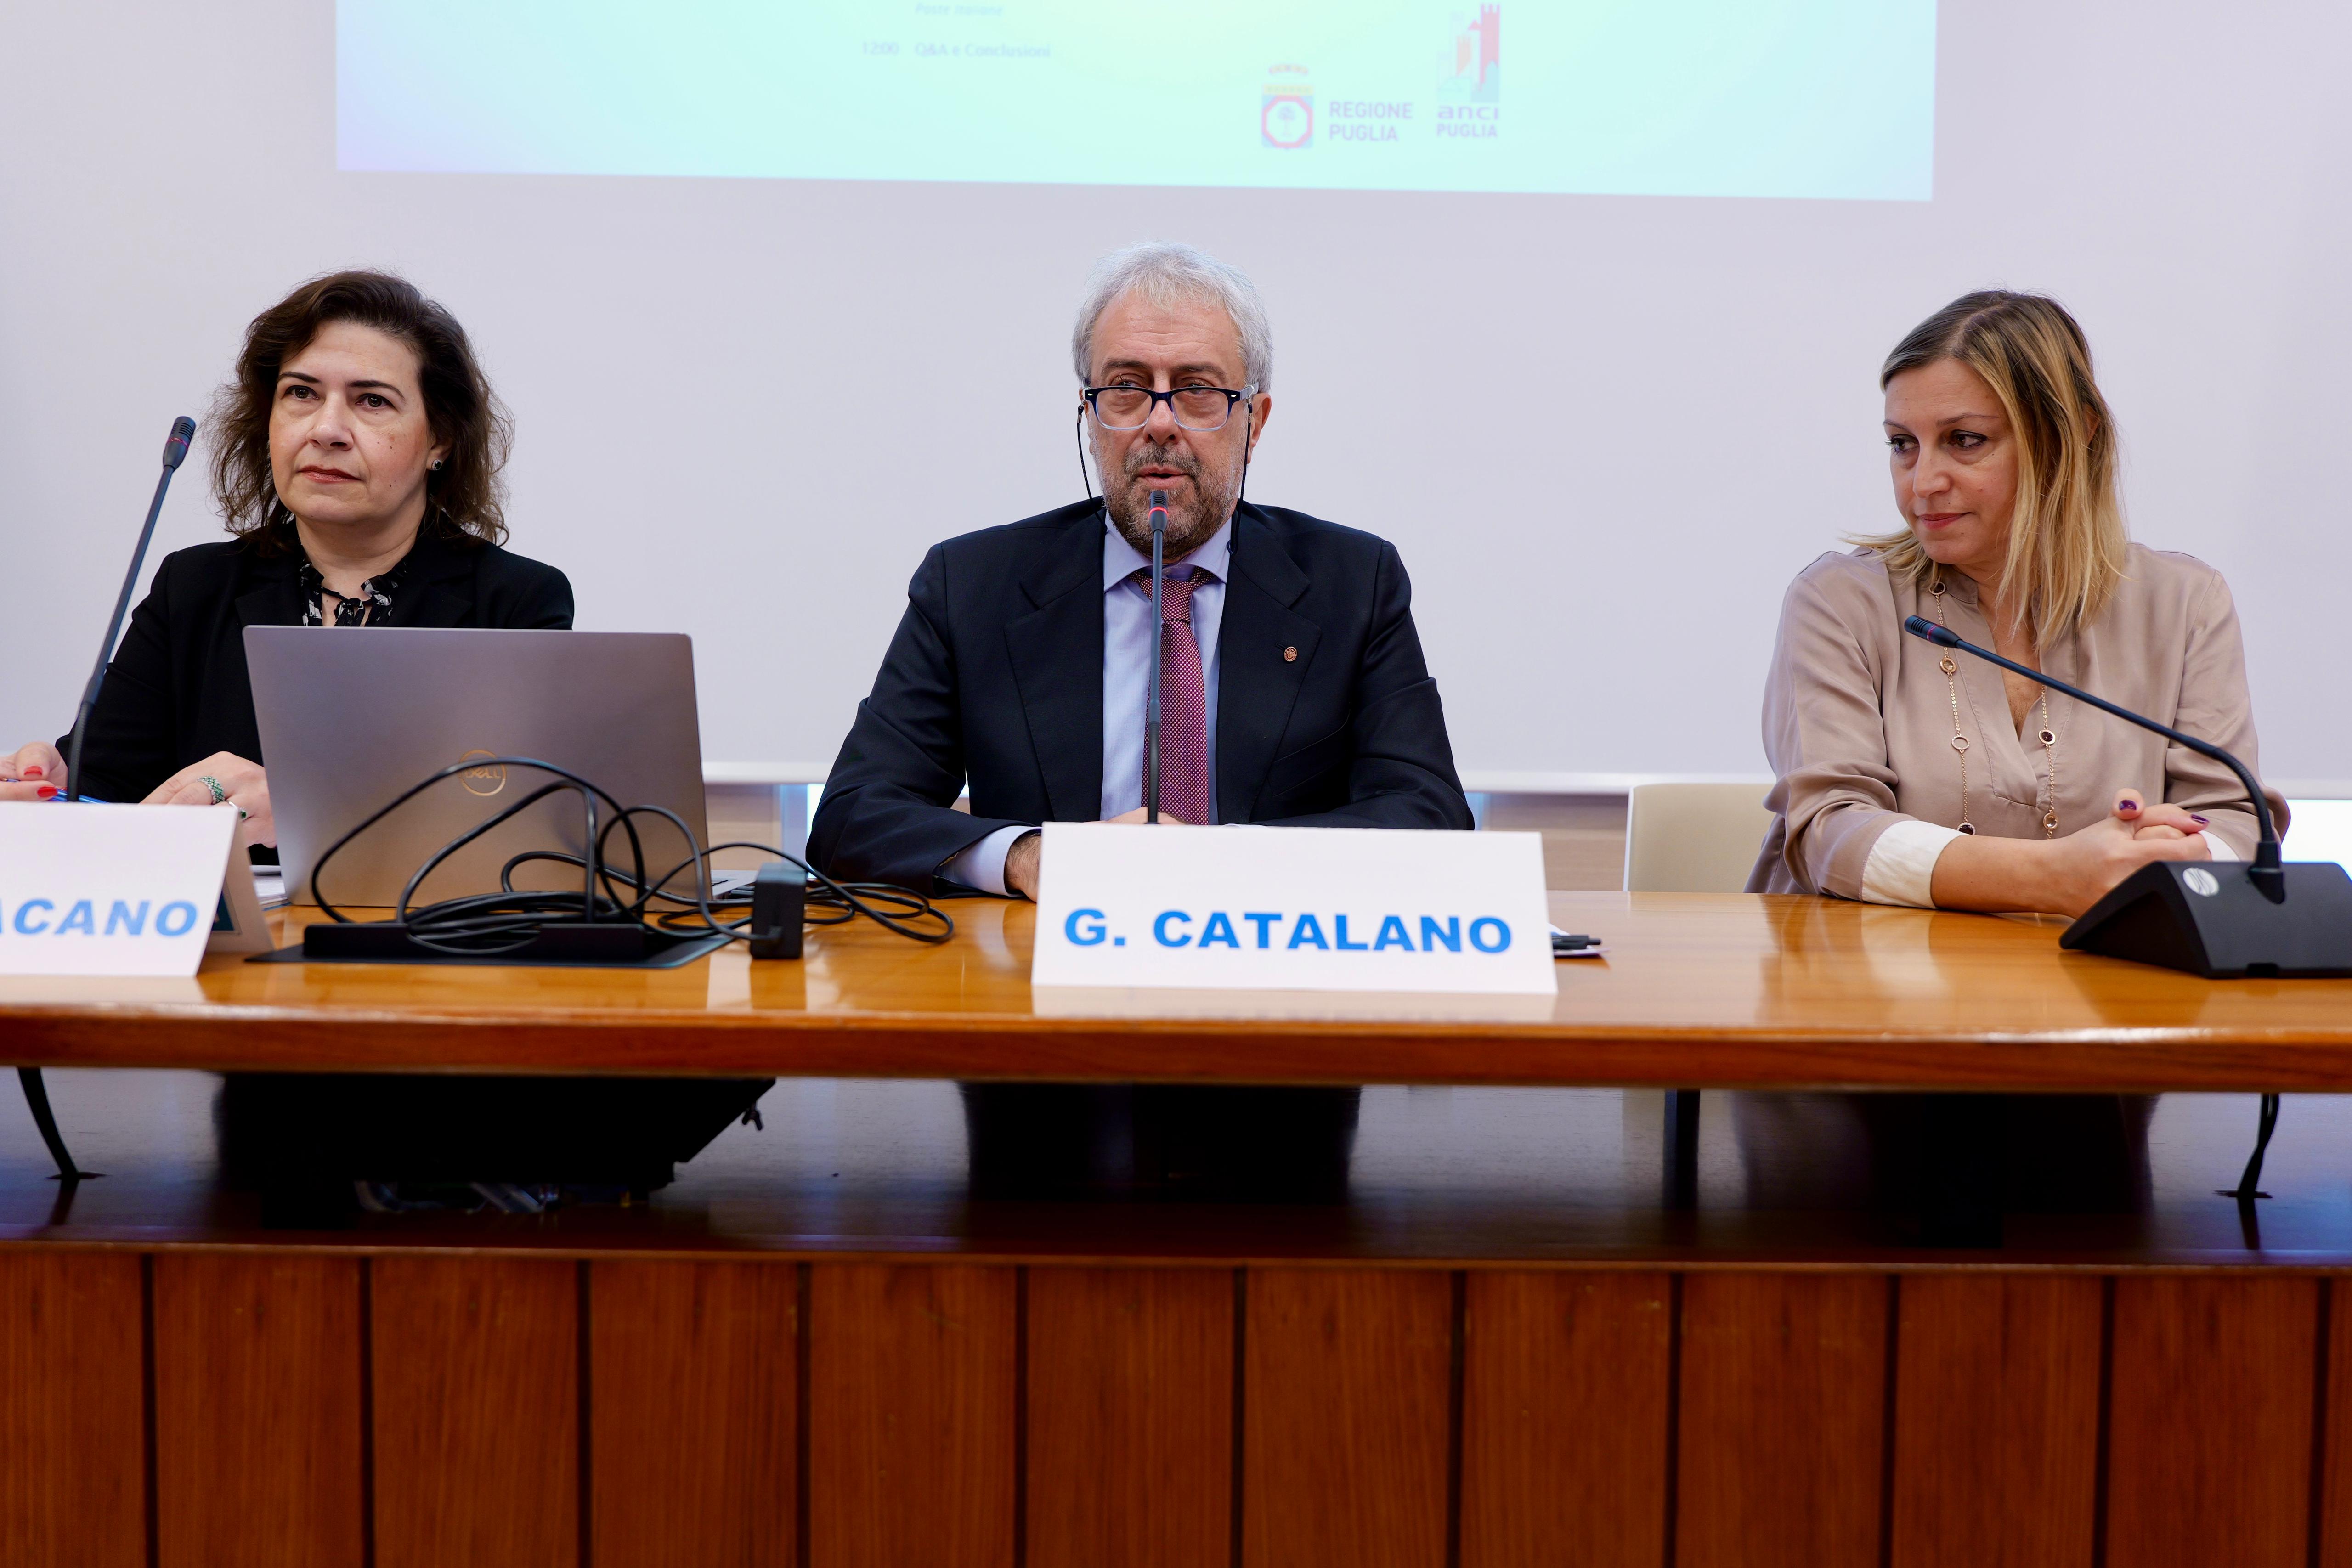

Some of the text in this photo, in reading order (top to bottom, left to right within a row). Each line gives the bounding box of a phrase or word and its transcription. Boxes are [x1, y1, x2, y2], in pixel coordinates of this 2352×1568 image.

[862, 42, 1051, 58] 12:00 Q&A e Conclusioni
[1329, 100, 1413, 119] REGIONE
[1437, 105, 1499, 120] anci
[1329, 124, 1399, 141] PUGLIA
[1436, 123, 1498, 138] PUGLIA
[0, 898, 198, 936] CANO
[1065, 908, 1511, 953] G. CATALANO
